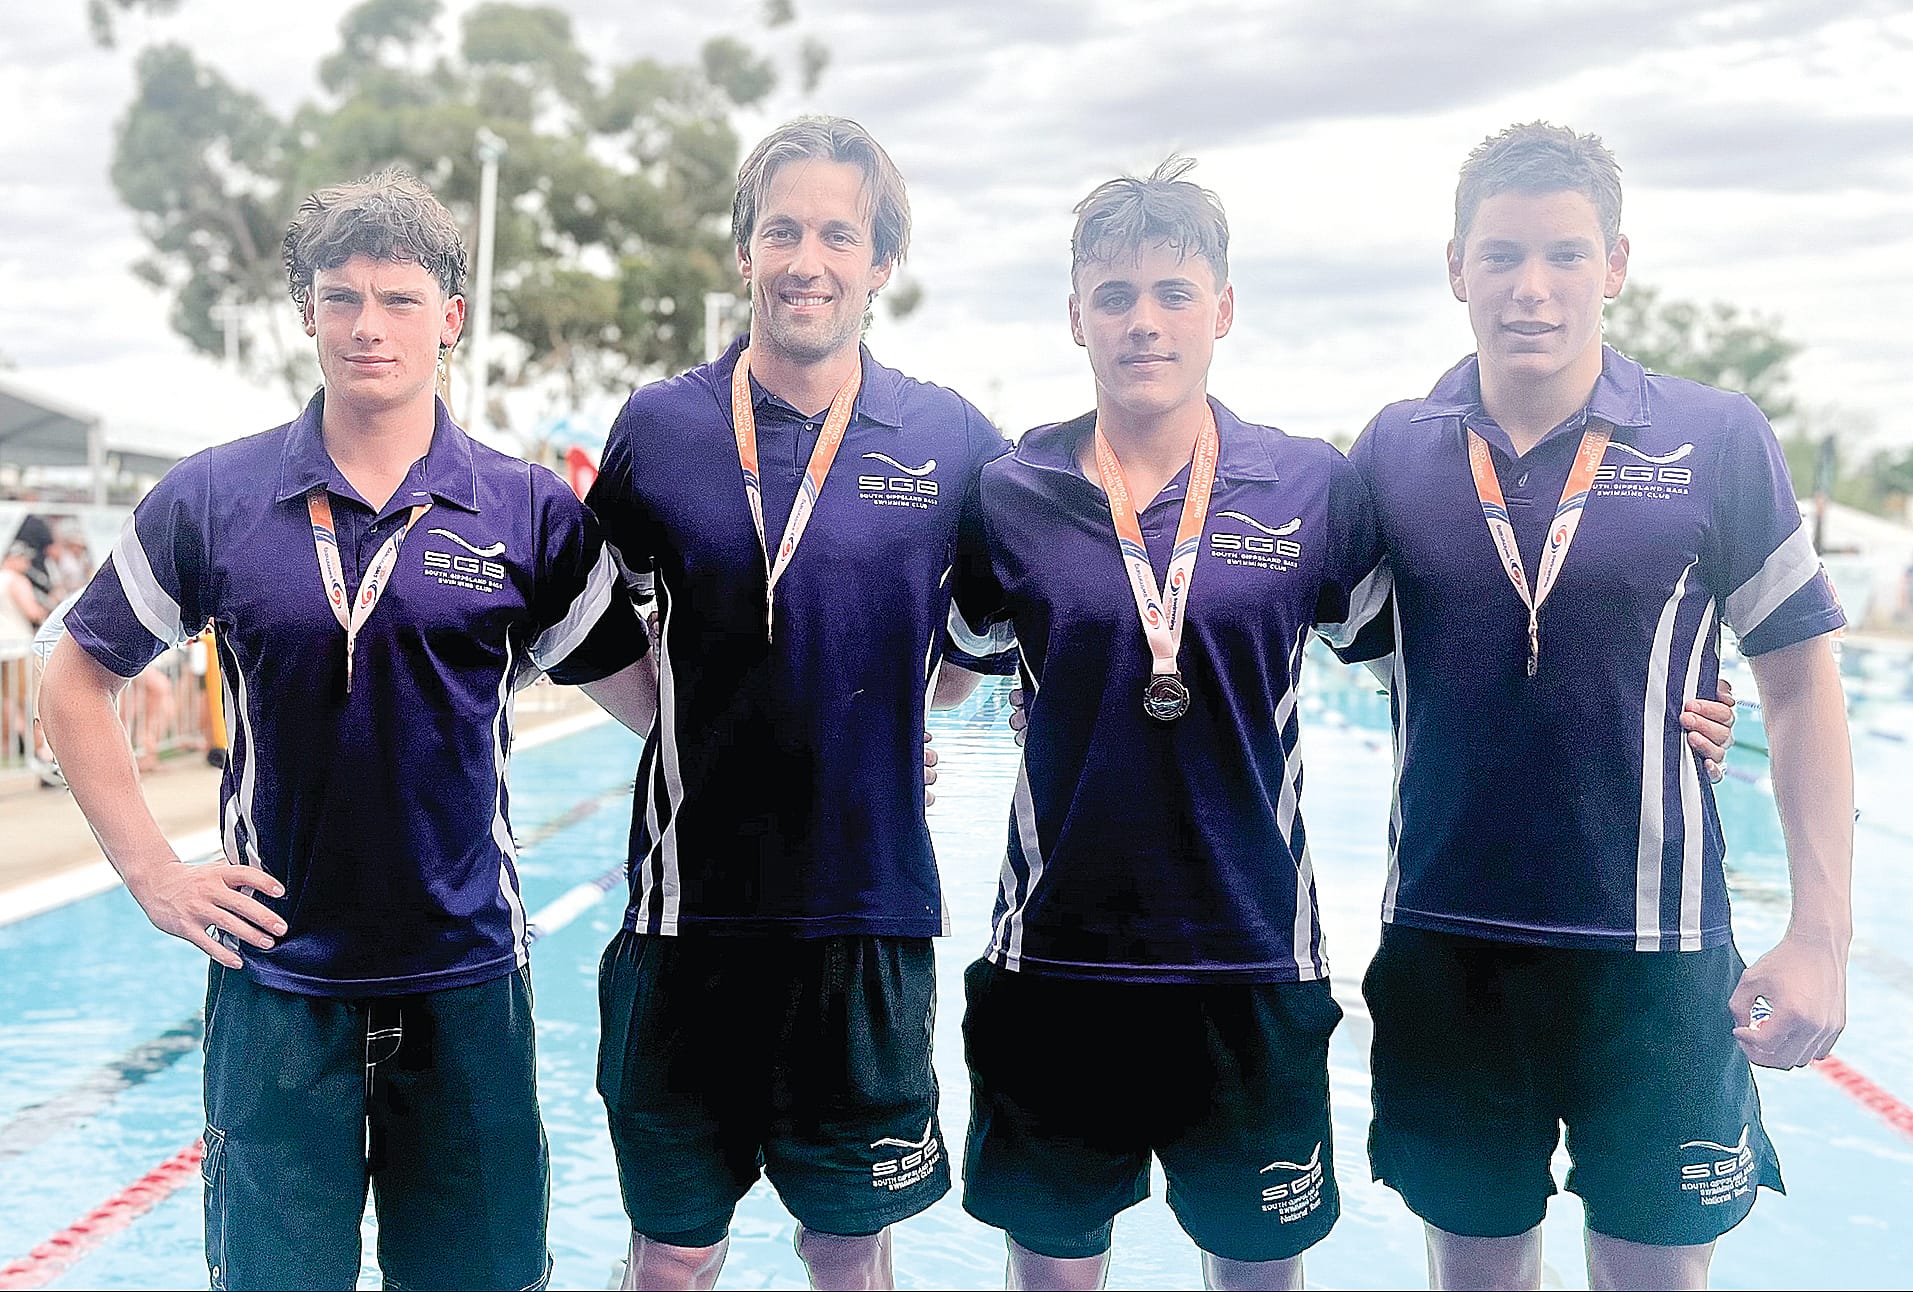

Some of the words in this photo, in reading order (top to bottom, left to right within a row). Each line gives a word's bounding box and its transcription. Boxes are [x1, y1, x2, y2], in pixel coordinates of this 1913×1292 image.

[858, 475, 939, 496] SGB
[1594, 465, 1692, 486] SGB
[1192, 494, 1205, 519] LONG
[1646, 492, 1671, 500] CLUB
[1211, 533, 1301, 558] SGB
[1211, 550, 1238, 558] SOUTH
[424, 551, 505, 580] SGB
[424, 569, 448, 577] SOUTH
[1269, 564, 1287, 572] CLUB
[872, 1138, 938, 1177] SGB
[1681, 1145, 1753, 1180] SGB
